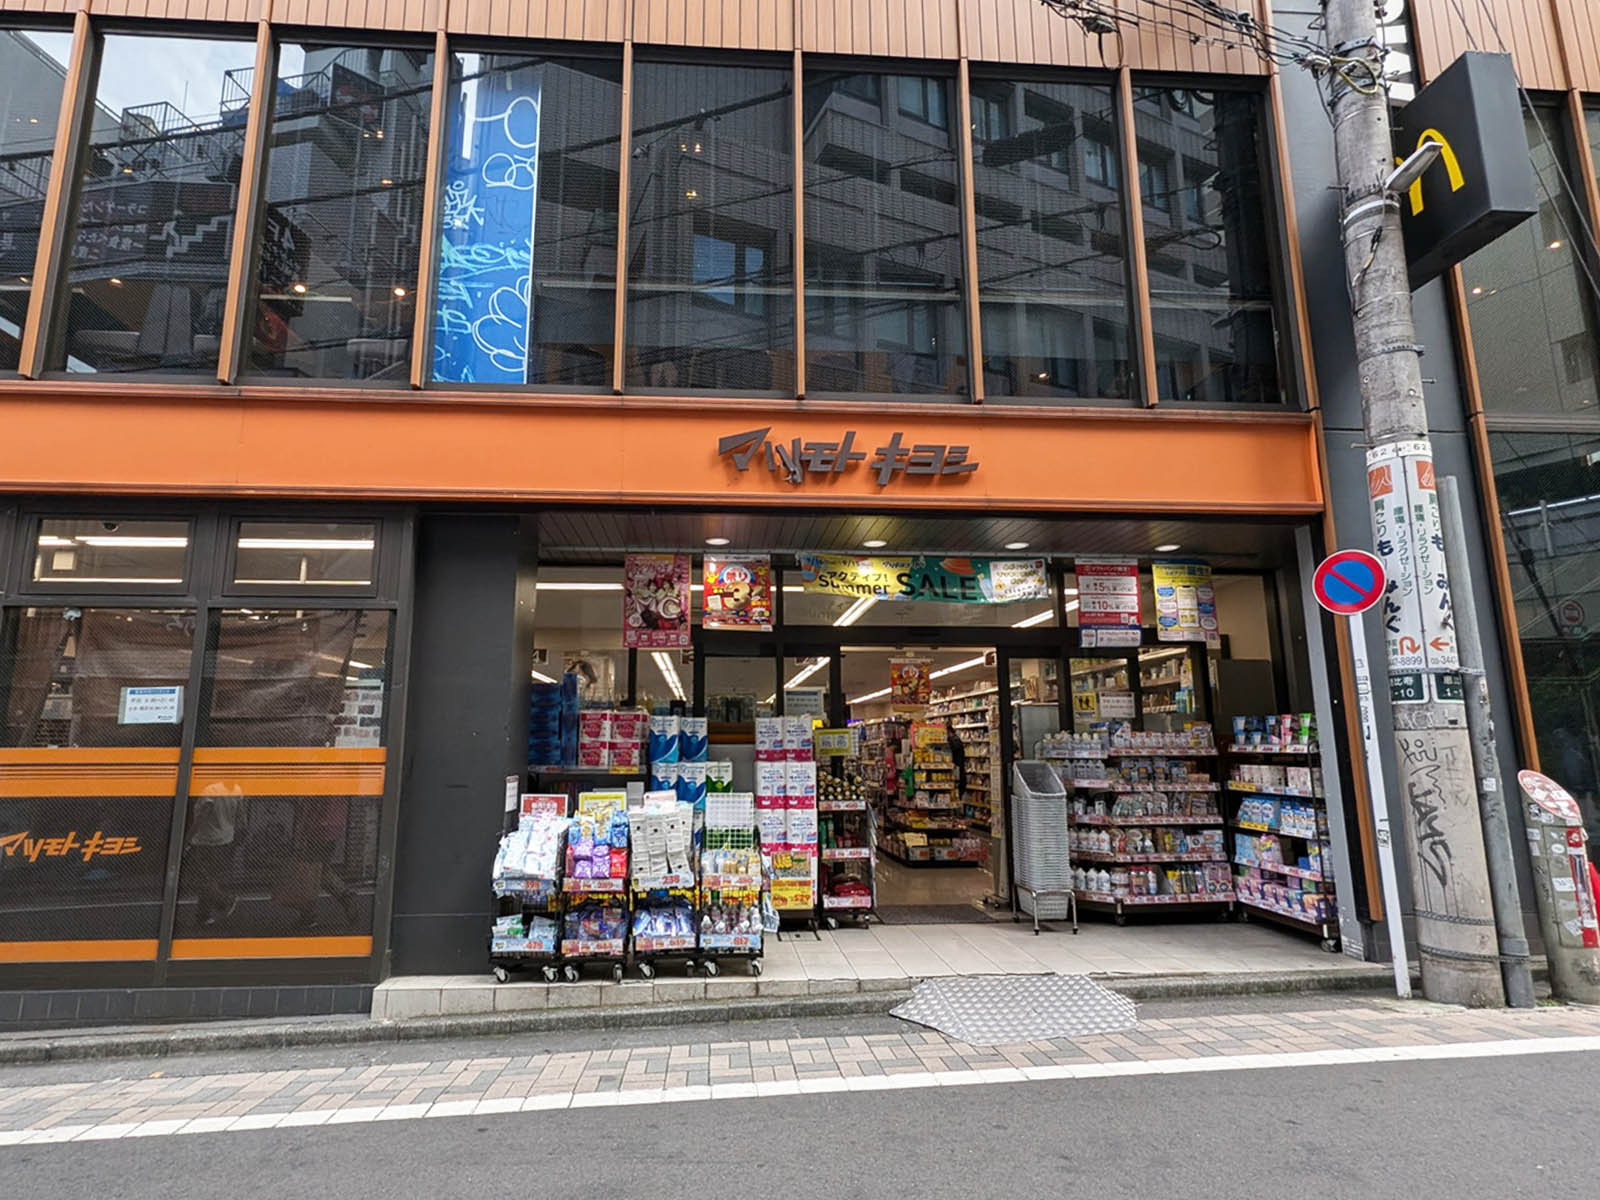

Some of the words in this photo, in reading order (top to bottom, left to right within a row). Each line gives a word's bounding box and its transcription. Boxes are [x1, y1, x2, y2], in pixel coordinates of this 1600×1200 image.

[718, 426, 980, 486] マツモトキヨシ
[818, 573, 891, 595] Summer
[896, 572, 979, 601] SALE
[1389, 677, 1414, 687] 比寿
[0, 831, 142, 861] マツモトキヨシ
